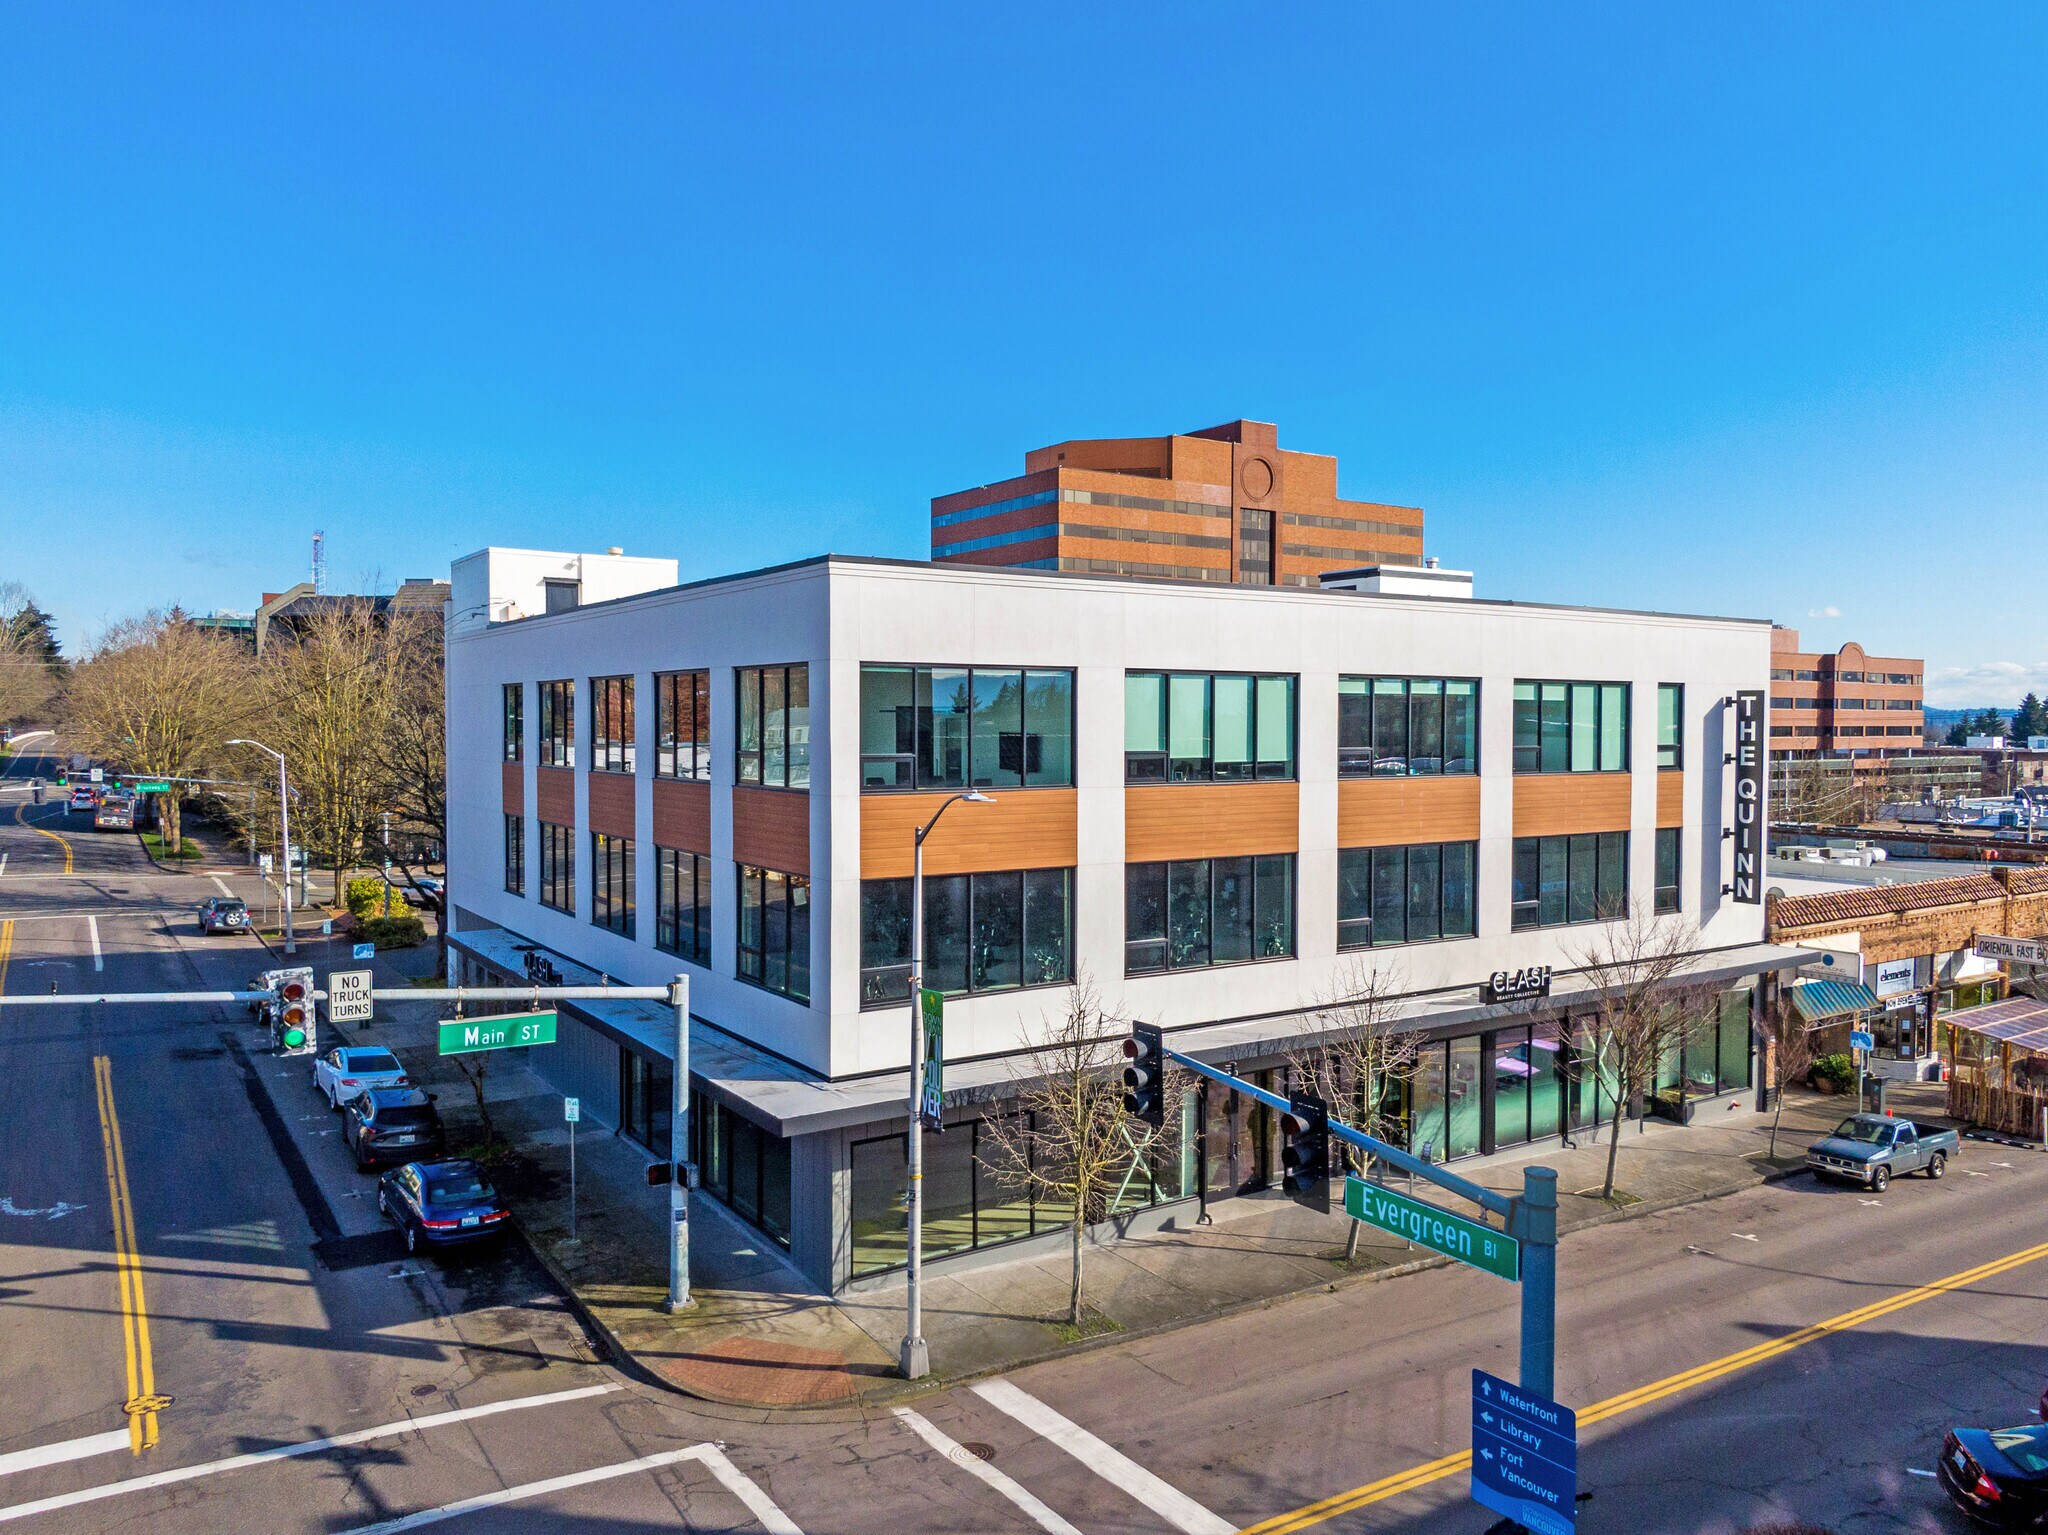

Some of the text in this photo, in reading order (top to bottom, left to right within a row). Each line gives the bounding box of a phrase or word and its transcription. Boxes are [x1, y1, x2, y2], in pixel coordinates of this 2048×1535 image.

[1736, 695, 1757, 899] THE QUINN
[1979, 940, 2014, 956] ORIENTAL
[2016, 945, 2035, 959] FAST
[342, 976, 360, 989] NO
[1493, 966, 1552, 993] CLASH
[1880, 968, 1912, 982] elements
[333, 989, 369, 1003] TRUCK
[1496, 990, 1540, 1001] BEAUTY COLLECTIVE
[333, 1003, 369, 1017] TURNS
[464, 1024, 540, 1047] Main ST
[921, 1086, 941, 1120] VER
[1362, 1186, 1472, 1257] Evergreen
[1499, 1388, 1558, 1425] Waterfront
[1500, 1418, 1542, 1450] Library
[1500, 1446, 1524, 1468] Fort
[1500, 1465, 1559, 1503] Vancouver
